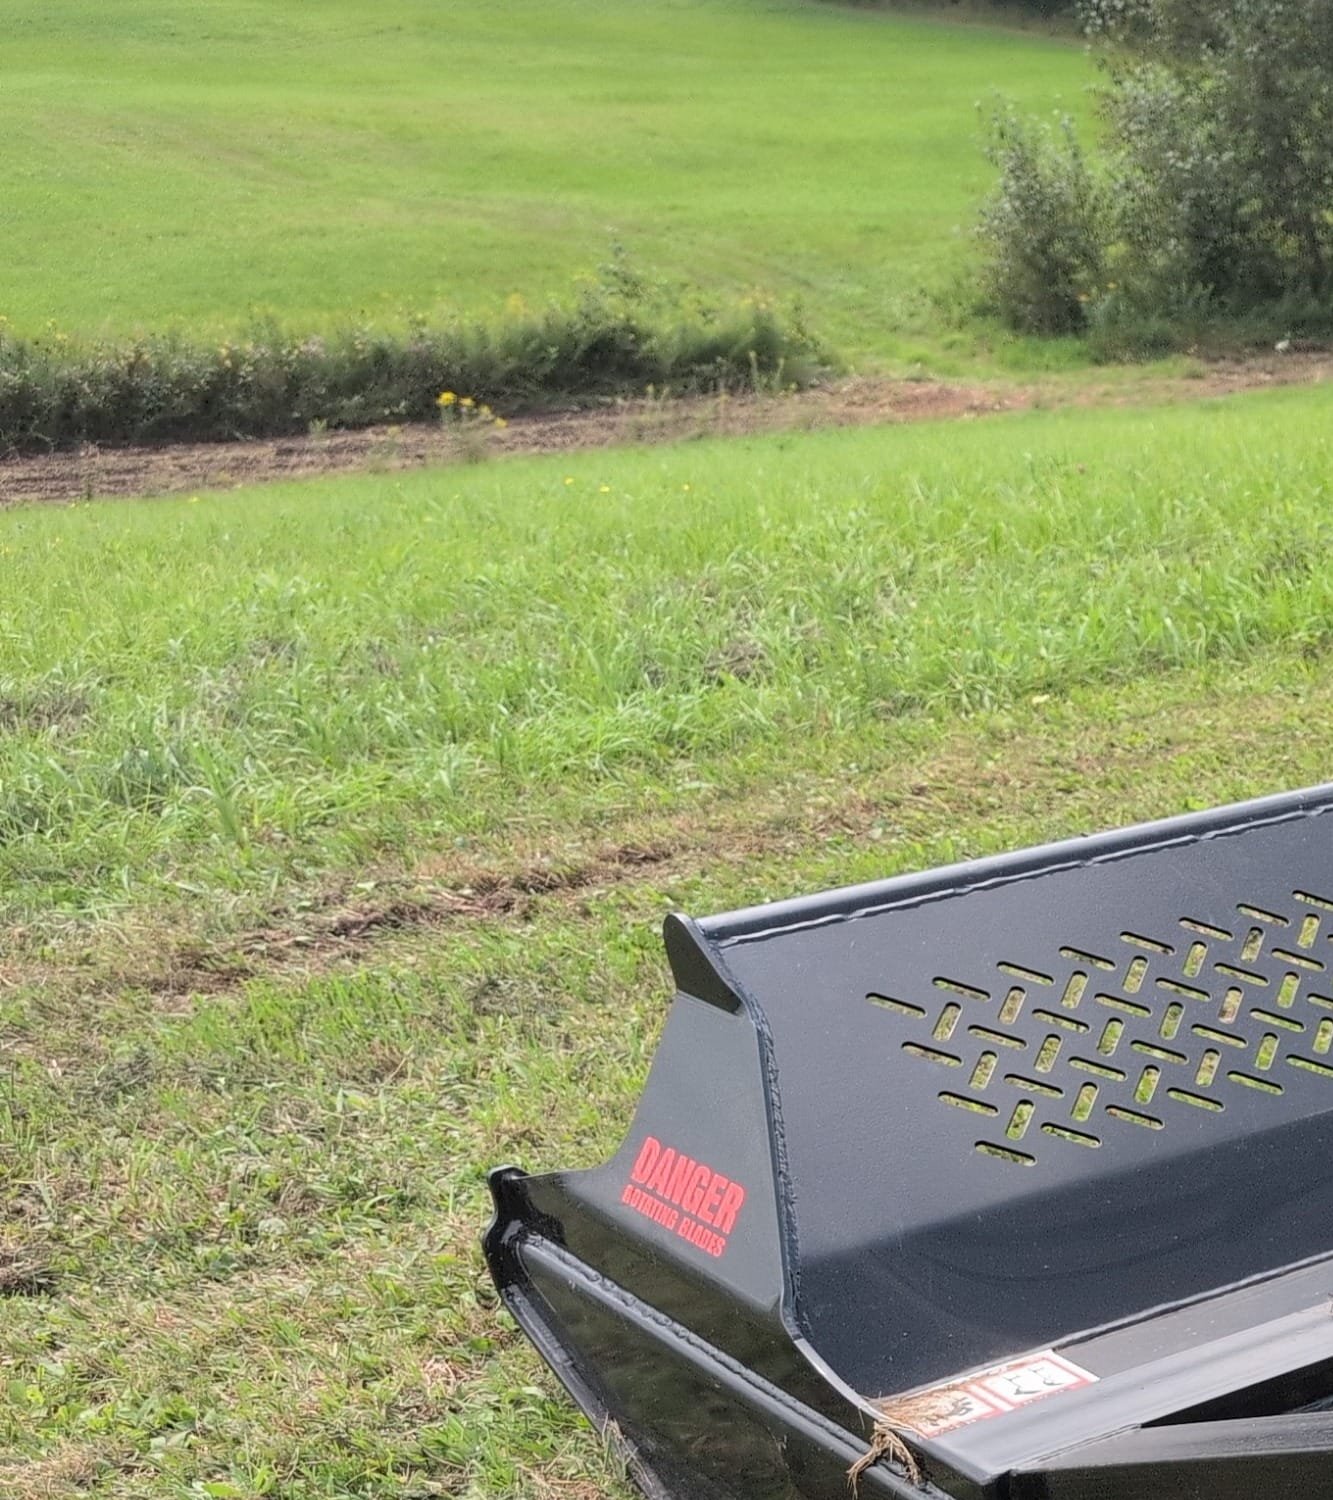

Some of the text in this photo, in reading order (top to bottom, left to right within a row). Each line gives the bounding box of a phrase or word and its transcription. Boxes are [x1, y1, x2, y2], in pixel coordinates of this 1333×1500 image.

[621, 1184, 726, 1257] ROTATING BLADES
[631, 1136, 744, 1235] DANGER
